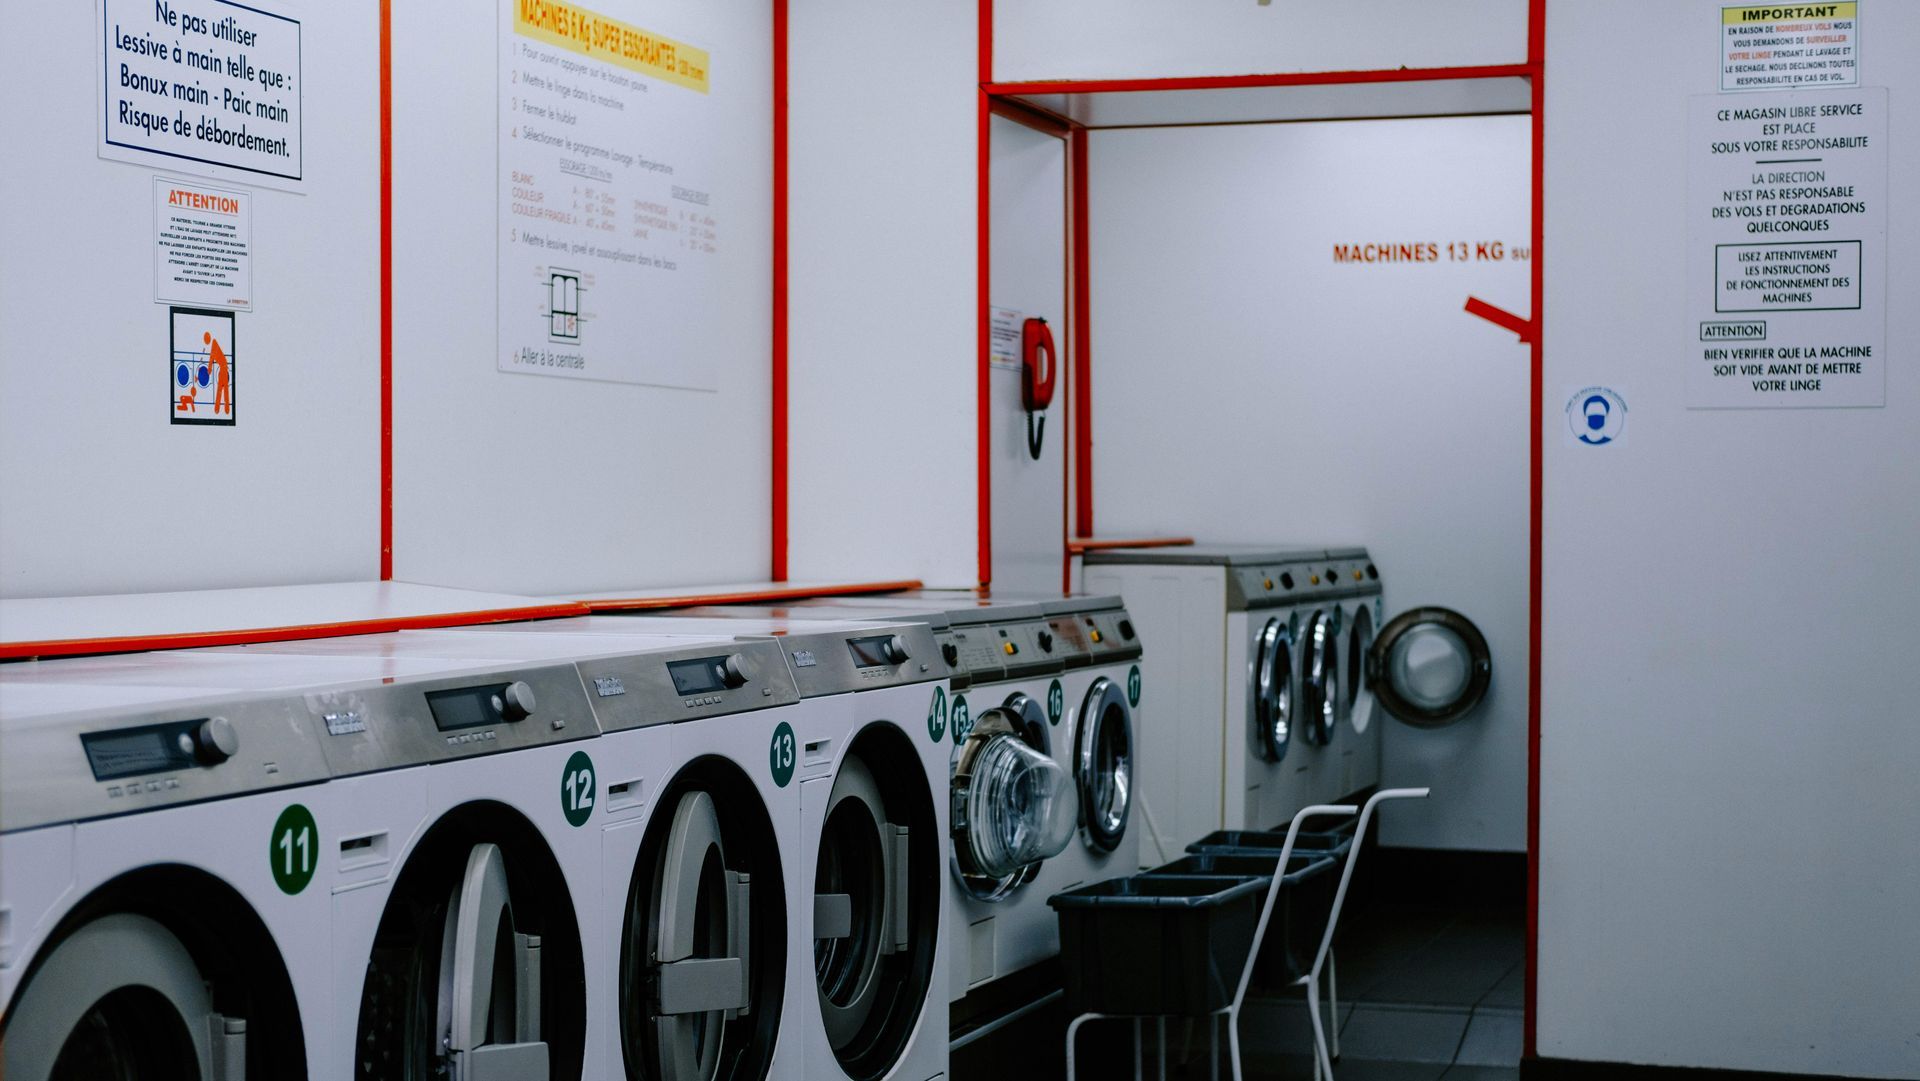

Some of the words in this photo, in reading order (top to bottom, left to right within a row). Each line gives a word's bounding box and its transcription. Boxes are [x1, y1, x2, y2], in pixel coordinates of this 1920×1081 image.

[1742, 6, 1838, 21] IMPORTANT
[156, 0, 177, 27] Ne
[182, 14, 207, 36] pas
[212, 17, 257, 47] utiliser
[1739, 26, 1763, 35] RAISON
[1765, 25, 1773, 33] DE
[1833, 21, 1852, 30] NOUS
[520, 0, 569, 36] MACHINES
[571, 11, 577, 40] 6
[579, 14, 590, 51] Kg
[593, 19, 621, 53] SUPER
[624, 30, 676, 72] ESSORANTES
[1733, 39, 1751, 48] VOUS
[1753, 38, 1794, 47] DEMANDONS
[1807, 35, 1846, 43] SURVEILLER
[116, 25, 168, 60] Lessive
[172, 40, 181, 64] à
[187, 48, 222, 74] main
[227, 54, 254, 81] telle
[259, 69, 283, 92] que
[522, 43, 539, 60] Pour
[1729, 52, 1749, 60] VOTRE
[1752, 51, 1770, 59] LINGE
[1773, 49, 1804, 58] PENDANT
[1806, 49, 1813, 57] LE
[1815, 47, 1841, 56] LAVAGE
[1842, 47, 1851, 55] ET
[1725, 65, 1733, 73] LE
[1735, 64, 1766, 73] SECHAGE.
[1769, 63, 1787, 71] NOUS
[1789, 61, 1827, 70] DECLINONS
[1829, 59, 1855, 68] TOUTES
[522, 72, 545, 89] Mettre
[546, 79, 553, 92] le
[1736, 75, 1791, 85] RESPONSABILITE
[1794, 75, 1803, 83] EN
[1804, 74, 1818, 82] CAS
[1819, 73, 1828, 81] DE
[1830, 73, 1844, 81] VOL.
[121, 63, 168, 97] Bonux
[173, 80, 208, 106] main
[224, 88, 251, 115] Paic
[256, 99, 288, 123] main
[522, 99, 547, 118] Fermer
[548, 105, 555, 120] le
[1717, 110, 1730, 121] CE
[1733, 108, 1786, 120] MAGASIN
[1790, 106, 1816, 118] LIBRE
[1820, 104, 1862, 117] SERVICE
[119, 100, 168, 136] Risque
[173, 110, 191, 137] de
[196, 115, 290, 157] débordement.
[1763, 124, 1780, 135] EST
[1784, 122, 1815, 134] PLACE
[1712, 142, 1740, 154] SOUS
[1744, 140, 1777, 152] VOTRE
[1782, 136, 1868, 150] RESPONSABILITE
[1752, 173, 1765, 185] LA
[1768, 171, 1825, 184] DIRECTION
[169, 190, 238, 213] ATTENTION
[1724, 190, 1752, 201] N'EST
[1756, 189, 1776, 200] PAS
[1779, 186, 1854, 199] RESPONSABLE
[1712, 207, 1731, 218] DES
[1735, 206, 1762, 217] VOLS
[1766, 205, 1776, 216] ET
[1780, 201, 1865, 216] DEGRADATIONS
[1747, 219, 1829, 233] QUELCONQUES
[1334, 244, 1438, 262] MACHINES
[1448, 243, 1468, 260] 13
[1476, 242, 1504, 260] KG
[1738, 252, 1761, 262] LISEZ
[1764, 249, 1837, 261] ATTENTIVEMENT
[1745, 266, 1760, 276] LES
[1762, 264, 1830, 275] INSTRUCTIONS
[1726, 281, 1736, 290] DE
[1741, 278, 1829, 290] FONCTIONNEMENT
[1832, 277, 1850, 287] DES
[1762, 292, 1812, 303] MACHINES
[1705, 325, 1762, 336] ATTENTION
[521, 347, 540, 365] Aller
[556, 353, 585, 370] centrale
[1704, 349, 1728, 360] BIEN
[1731, 348, 1774, 359] VERIFIER
[1778, 347, 1800, 359] QUE
[1804, 347, 1817, 358] LA
[1820, 346, 1871, 358] MACHINE
[1714, 365, 1736, 376] SOIT
[1740, 364, 1763, 375] VIDE
[1768, 363, 1802, 375] AVANT
[1806, 363, 1818, 374] DE
[1822, 362, 1861, 374] METTRE
[1752, 380, 1786, 391] VOTRE
[1790, 379, 1821, 391] LINGE
[1129, 674, 1139, 699] 17
[1050, 689, 1061, 717] 16
[931, 695, 944, 731] 14
[953, 705, 966, 736] 15
[774, 734, 792, 769] 13
[566, 768, 592, 811] 12
[280, 826, 309, 875] 11
